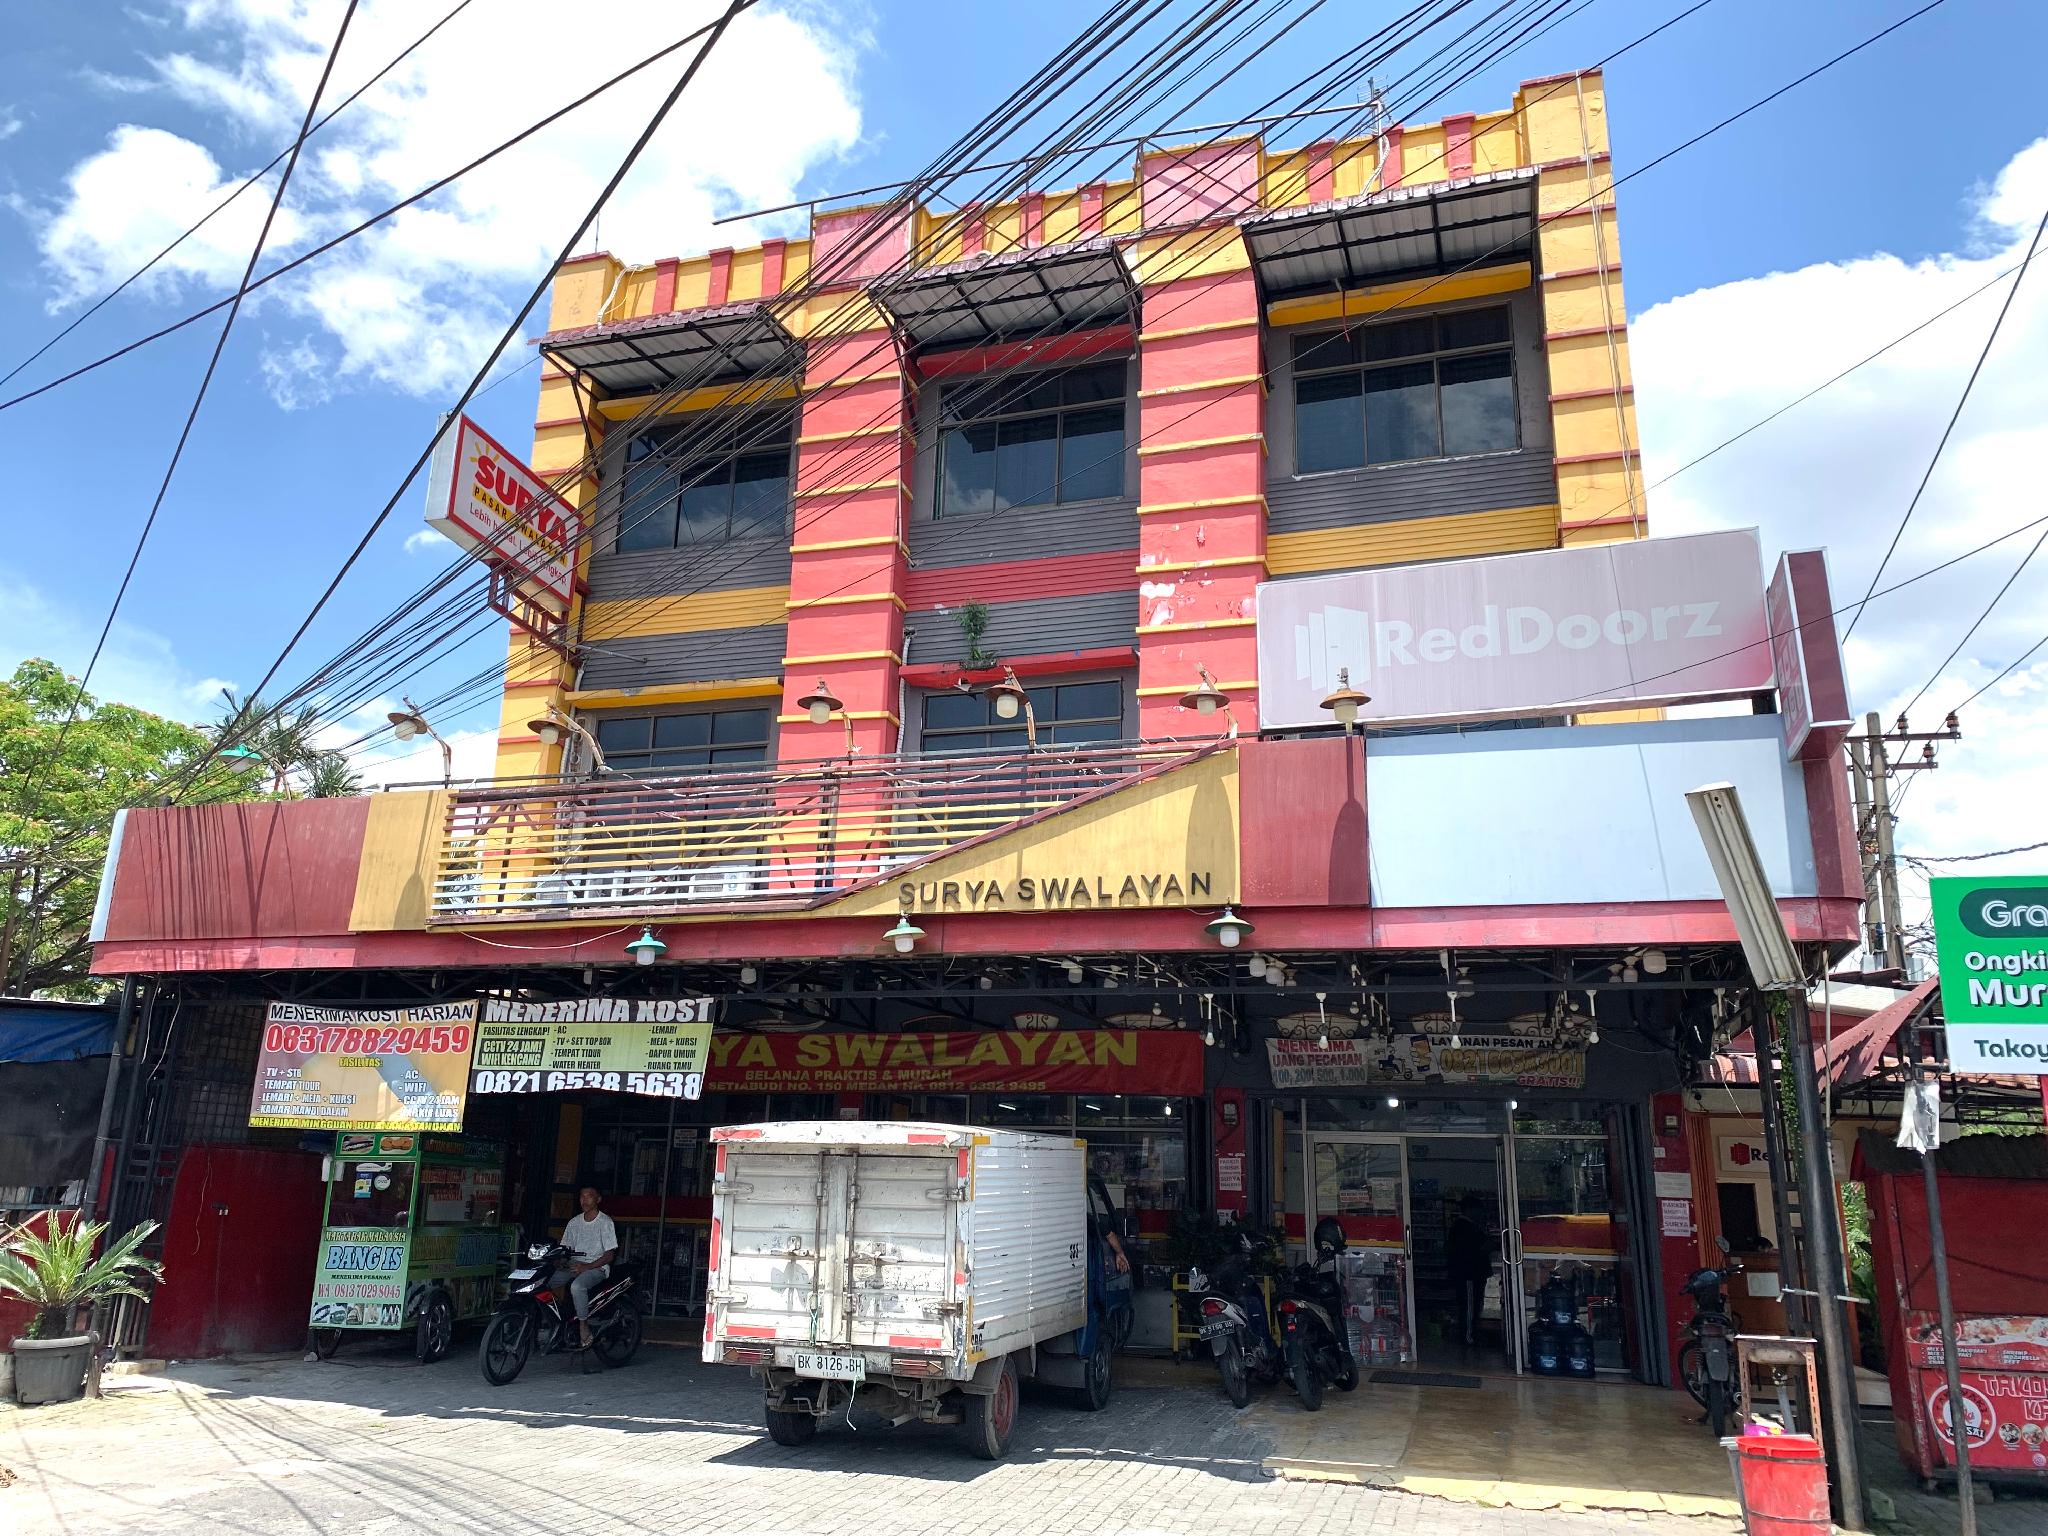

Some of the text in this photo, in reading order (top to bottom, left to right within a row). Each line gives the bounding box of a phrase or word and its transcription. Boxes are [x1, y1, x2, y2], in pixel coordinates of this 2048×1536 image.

[474, 486, 508, 520] PASAR
[475, 454, 568, 548] SURYA
[469, 502, 491, 527] Lebih
[1374, 601, 1723, 668] RedDoorz
[899, 872, 1211, 905] SURYA SWALAYAN
[1964, 949, 2048, 977] Ongki
[270, 1004, 474, 1022] MENERIMA KOST HARIAN
[485, 997, 714, 1023] MENERIMA KOST
[483, 1026, 550, 1036] FASILITAS LENGKAP!
[265, 1023, 470, 1054] 083178829459
[571, 1037, 584, 1046] SET
[585, 1037, 598, 1046] TOP
[598, 1038, 611, 1046] BOX
[675, 1037, 697, 1047] KURSI
[1493, 1037, 1534, 1047] PESAN
[1538, 1038, 1580, 1049] ANAR
[484, 1040, 543, 1053] CCTV 24 JAM!
[796, 1032, 1137, 1067] SWALAYAN
[1277, 1039, 1355, 1053] MENEIMA
[481, 1053, 541, 1066] WIFI KENCANG
[581, 1049, 601, 1058] TIDUR
[673, 1049, 696, 1059] UMUM
[1273, 1053, 1363, 1067] UANG PECAHAN
[577, 1060, 601, 1070] HEATER
[673, 1061, 692, 1070] TAMU
[286, 1068, 302, 1078] STB
[745, 1070, 952, 1081] BELANJA PRAKTIS & MURAH
[299, 1081, 320, 1090] TIDUR
[475, 1070, 702, 1100] 0821 6538 5638
[708, 1081, 782, 1091] SETIABUDI
[788, 1082, 812, 1091] NO.
[818, 1082, 841, 1091] 150
[849, 1081, 898, 1091] MEDAN
[929, 1081, 965, 1091] 0812
[329, 1094, 356, 1104] KURSI
[292, 1105, 319, 1115] MANDI
[321, 1106, 348, 1116] DALAM
[435, 1109, 458, 1118] LUAS
[251, 1117, 299, 1128] MENERIMA
[325, 1245, 382, 1270] BANG
[381, 1246, 404, 1270] IS
[334, 1283, 355, 1298] 0813
[356, 1283, 378, 1299] 7029
[378, 1284, 401, 1299] 8045
[798, 1355, 862, 1373] BK 8126 BH
[1945, 1426, 1986, 1438] KSAI
